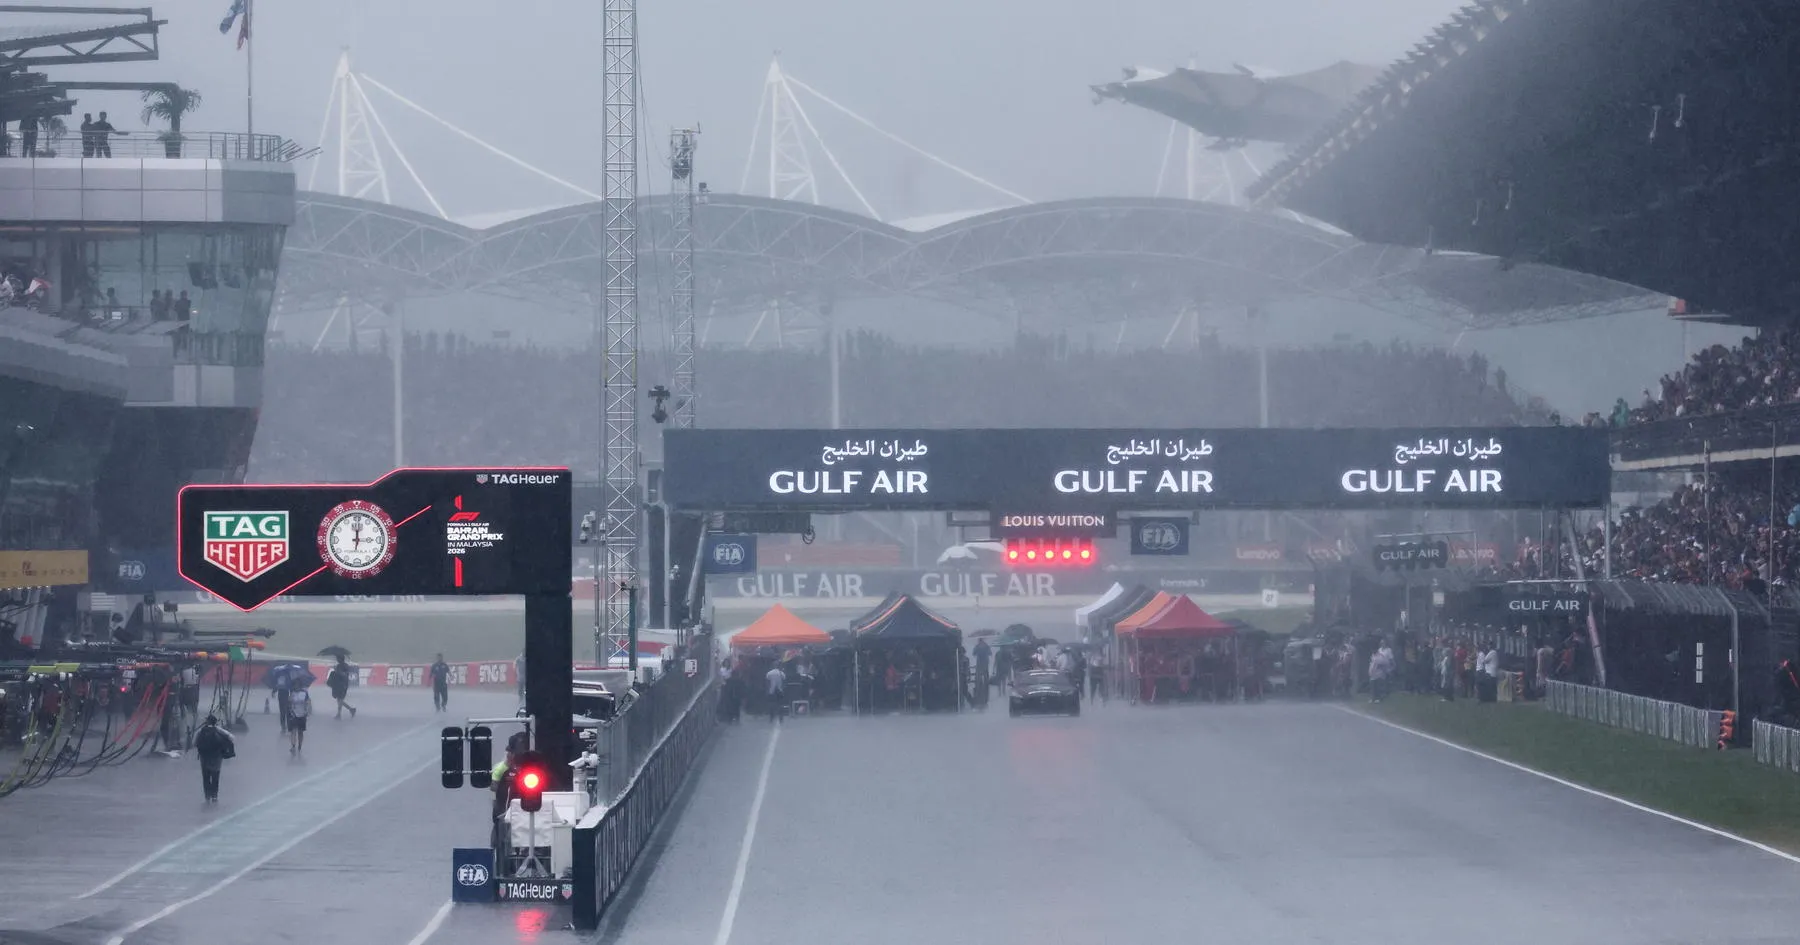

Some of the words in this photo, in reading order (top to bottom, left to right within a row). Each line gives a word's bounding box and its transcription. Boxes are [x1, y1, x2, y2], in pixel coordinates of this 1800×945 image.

[822, 440, 875, 465] الخليج
[880, 440, 928, 462] طيران
[1106, 438, 1160, 464] الخليج
[1165, 439, 1213, 461] طيران
[1395, 439, 1449, 464] الخليج
[1453, 439, 1502, 461] طيران
[769, 470, 863, 494] GULF
[870, 470, 928, 494] AIR
[1054, 470, 1147, 493] GULF
[1155, 470, 1213, 493] AIR
[1342, 469, 1436, 493] GULF
[1443, 469, 1502, 493] AIR
[211, 515, 281, 536] TAG
[1004, 516, 1045, 528] LOUIS
[1047, 515, 1105, 528] VUITTON
[447, 533, 481, 541] GRAND
[481, 533, 504, 541] PRIX
[209, 542, 284, 575] HEUER
[714, 547, 743, 562] FIA
[1236, 547, 1280, 560] Lenovo
[1380, 550, 1414, 561] GULF
[1418, 548, 1440, 558] AIR
[118, 564, 143, 577] FIA
[738, 573, 807, 599] GULF
[816, 573, 864, 598] AIR
[921, 572, 998, 597] GULF
[1006, 572, 1056, 597] AIR
[1509, 599, 1548, 611] GULF
[1553, 599, 1581, 611] AIR
[458, 868, 486, 882] FIA
